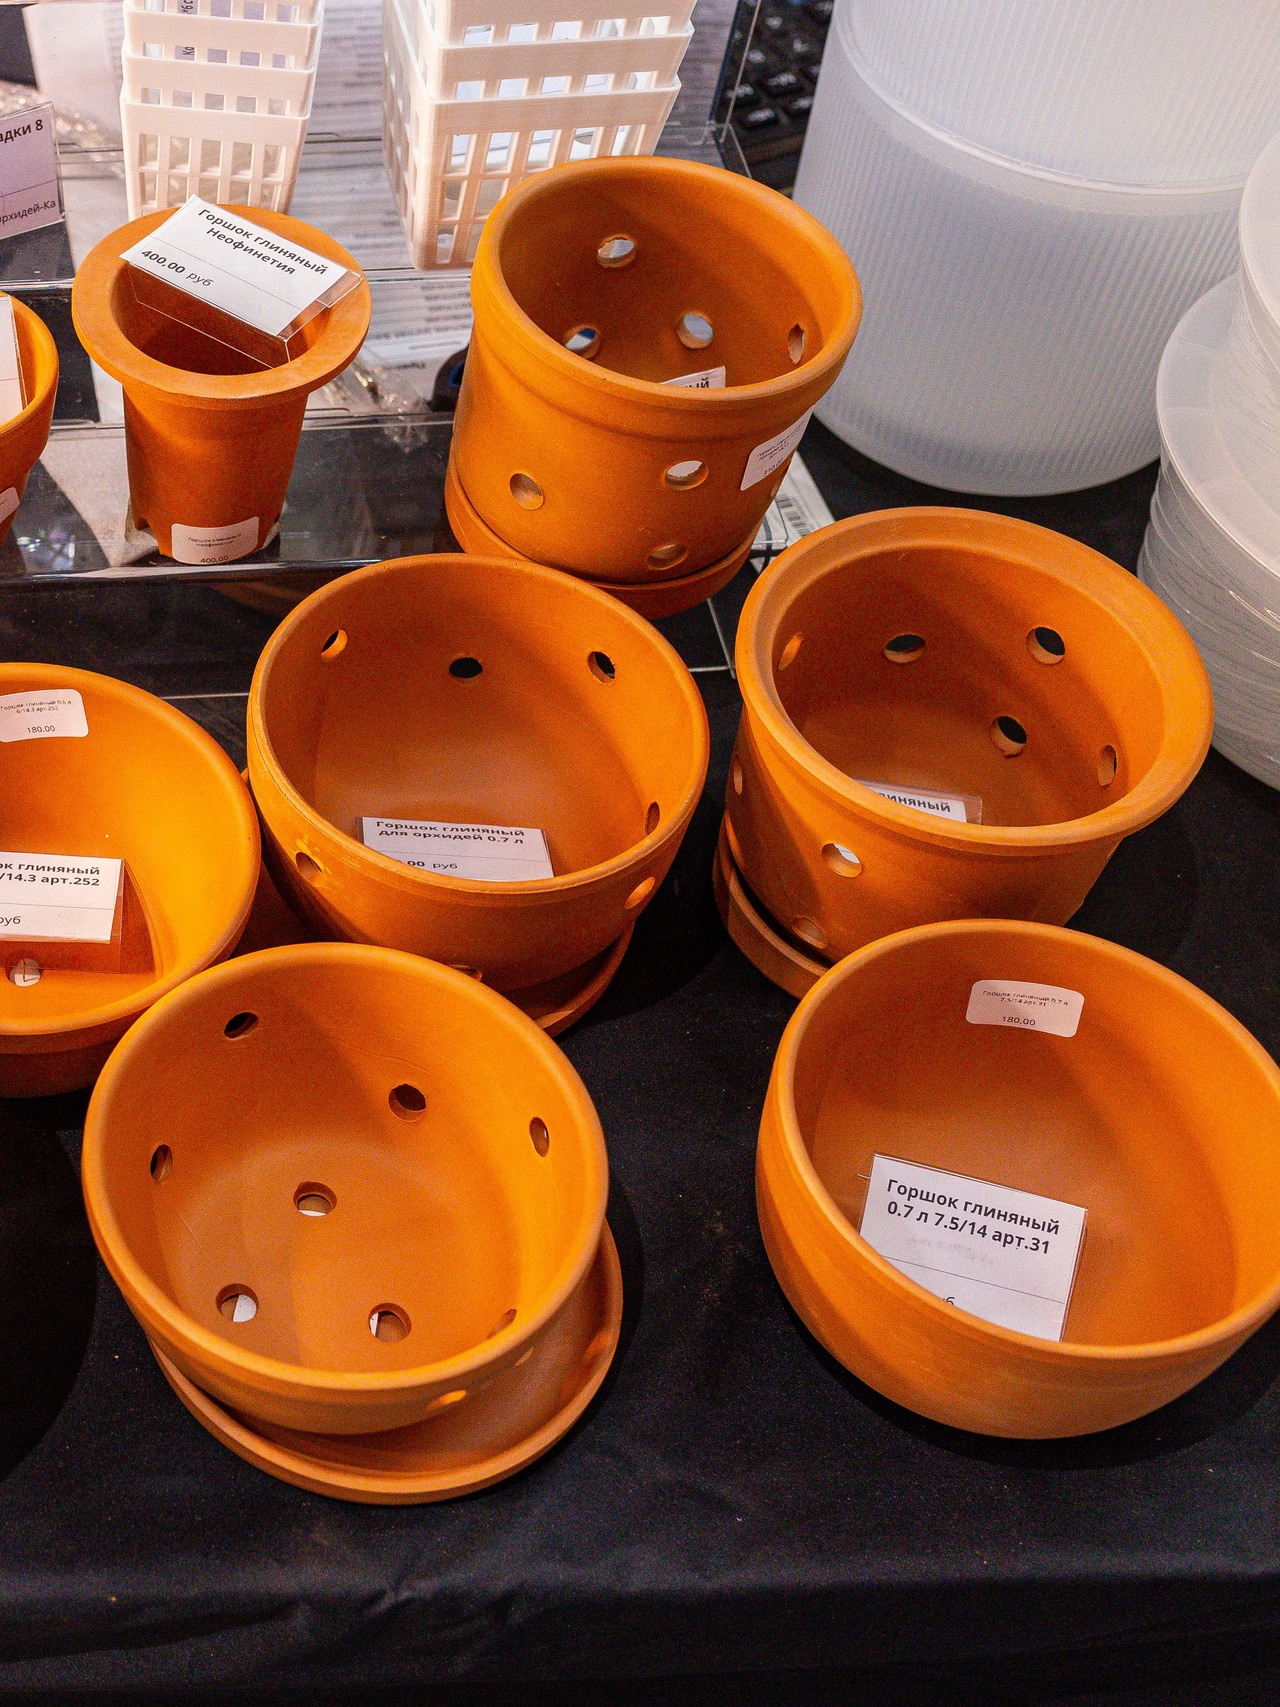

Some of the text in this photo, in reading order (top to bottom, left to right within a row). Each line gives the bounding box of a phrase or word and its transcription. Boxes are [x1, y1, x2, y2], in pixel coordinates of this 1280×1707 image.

[35, 119, 43, 130] 8
[198, 209, 328, 275] Горшок глиняный
[206, 227, 296, 275] Неофинетия
[141, 249, 214, 287] 400,00 руб
[27, 725, 55, 733] 180.00
[878, 792, 951, 812] иняный
[377, 821, 525, 836] Горшок глиняный
[379, 829, 408, 837] для
[413, 830, 483, 842] орхидей
[18, 863, 100, 875] глиняный
[41, 876, 100, 886] арт.252
[1002, 1016, 1036, 1026] 180.00
[887, 1179, 1060, 1235] Горшок глиняный
[887, 1201, 1051, 1255] 0.7 л 7.5/14 арт.31
